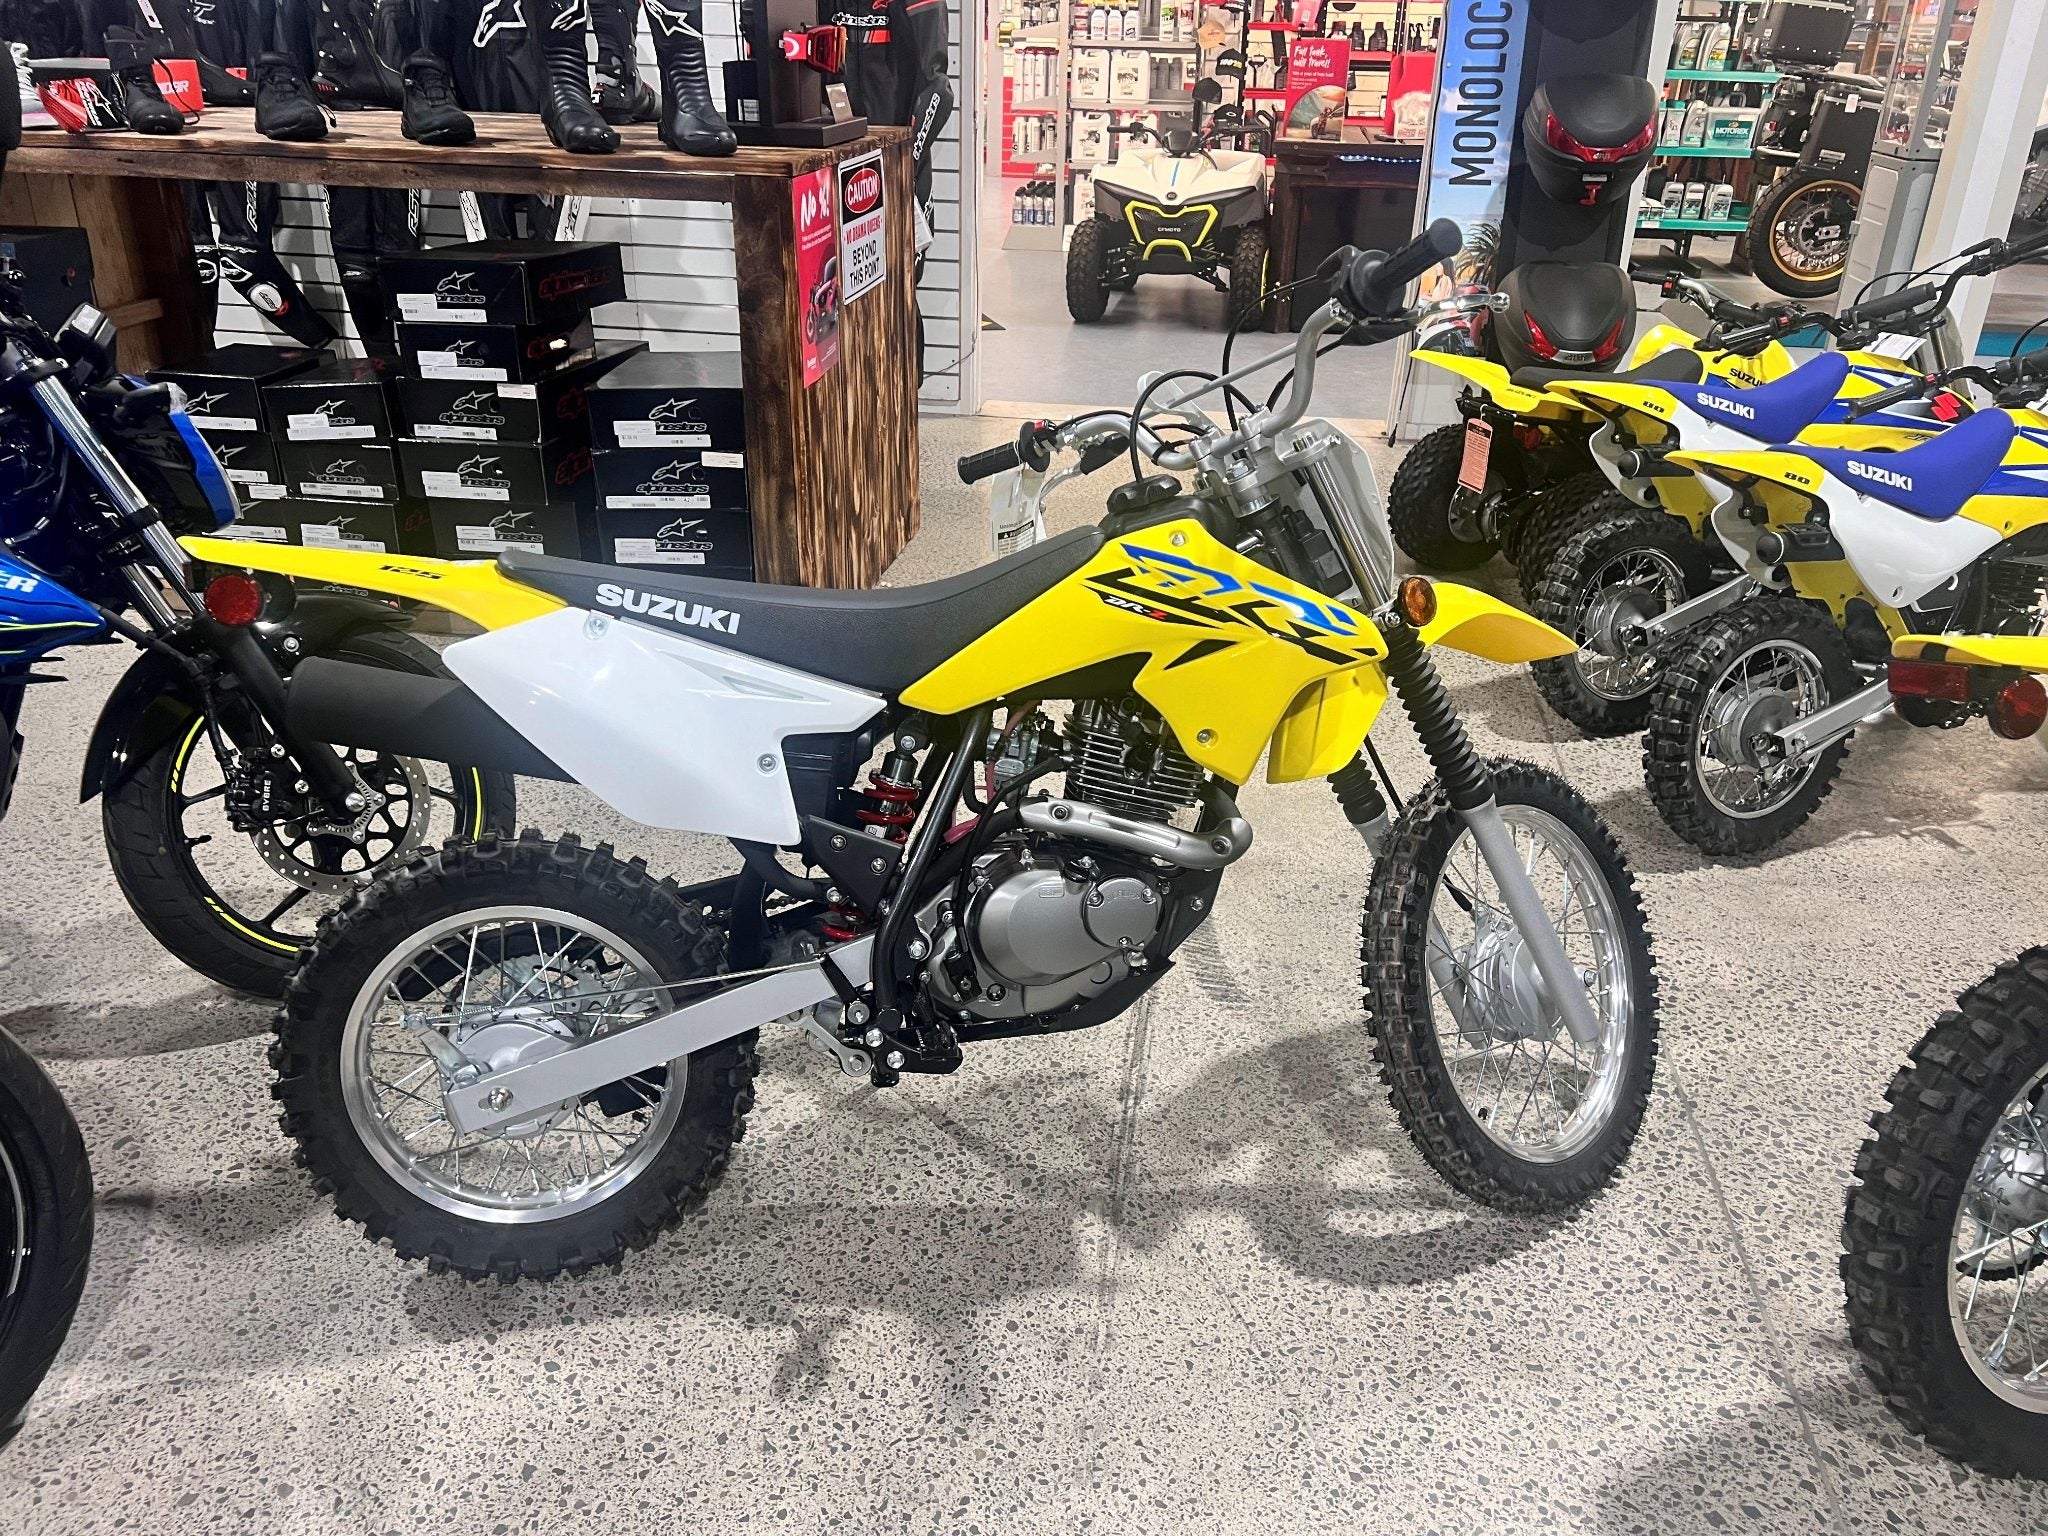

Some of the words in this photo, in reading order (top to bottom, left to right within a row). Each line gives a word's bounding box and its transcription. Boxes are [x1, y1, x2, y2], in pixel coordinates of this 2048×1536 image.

[831, 12, 890, 26] alpinestars
[1448, 1, 1513, 187] MONOLOC
[912, 93, 941, 160] alpinestars
[1715, 127, 1749, 135] MOTOREX
[847, 174, 879, 206] CAUTION
[801, 188, 817, 233] No
[853, 240, 877, 266] BEYOND
[850, 266, 863, 289] THIS
[864, 257, 880, 281] POINT
[439, 411, 506, 425] alpinestars
[1696, 392, 1755, 420] SUZUKI
[636, 482, 710, 495] alpinestars
[1784, 472, 1811, 485] 80
[1847, 460, 1913, 491] SUZUKI
[379, 565, 446, 580] 125
[595, 583, 741, 635] SUZUKI
[1104, 595, 1168, 620] DR-Z
[262, 779, 272, 811] BYBRE
